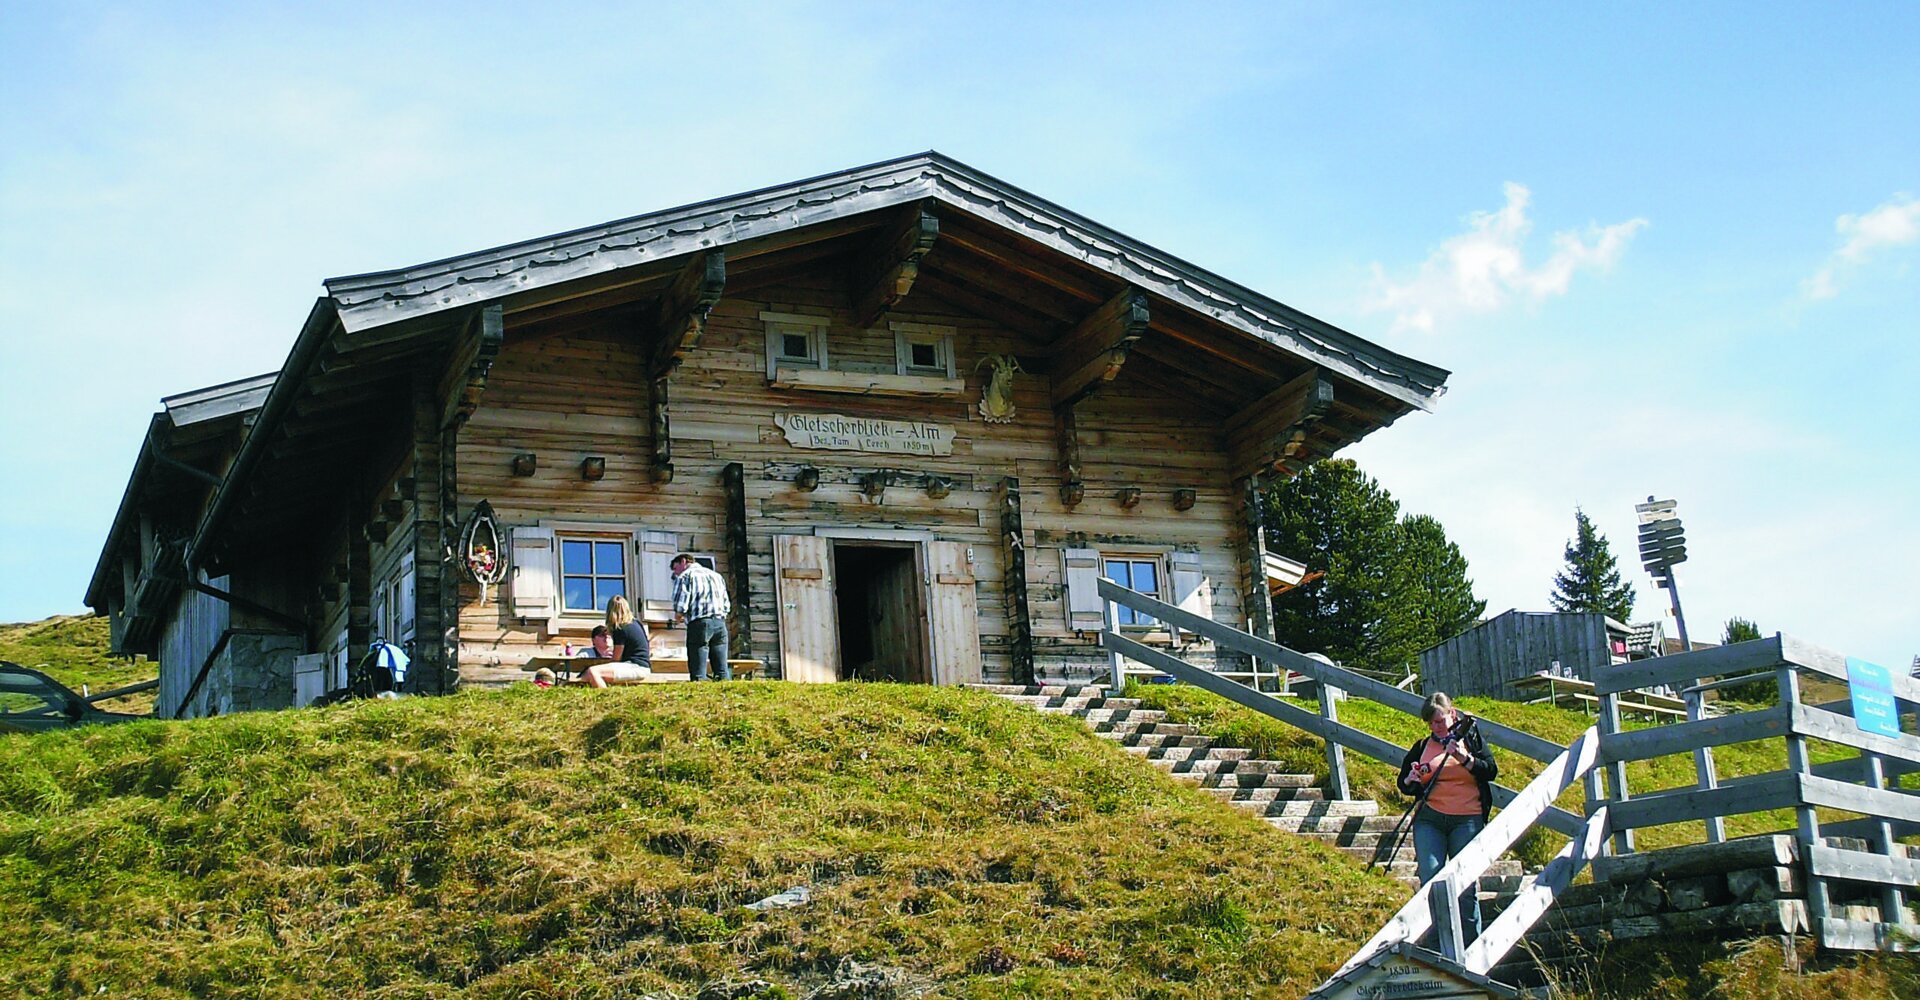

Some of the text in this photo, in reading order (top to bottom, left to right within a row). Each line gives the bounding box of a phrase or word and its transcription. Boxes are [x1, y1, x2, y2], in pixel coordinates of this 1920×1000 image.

[789, 414, 889, 437] Gletscherblick
[908, 422, 940, 440] Alm
[903, 441, 921, 450] 1850
[1389, 965, 1420, 976] 1850 m
